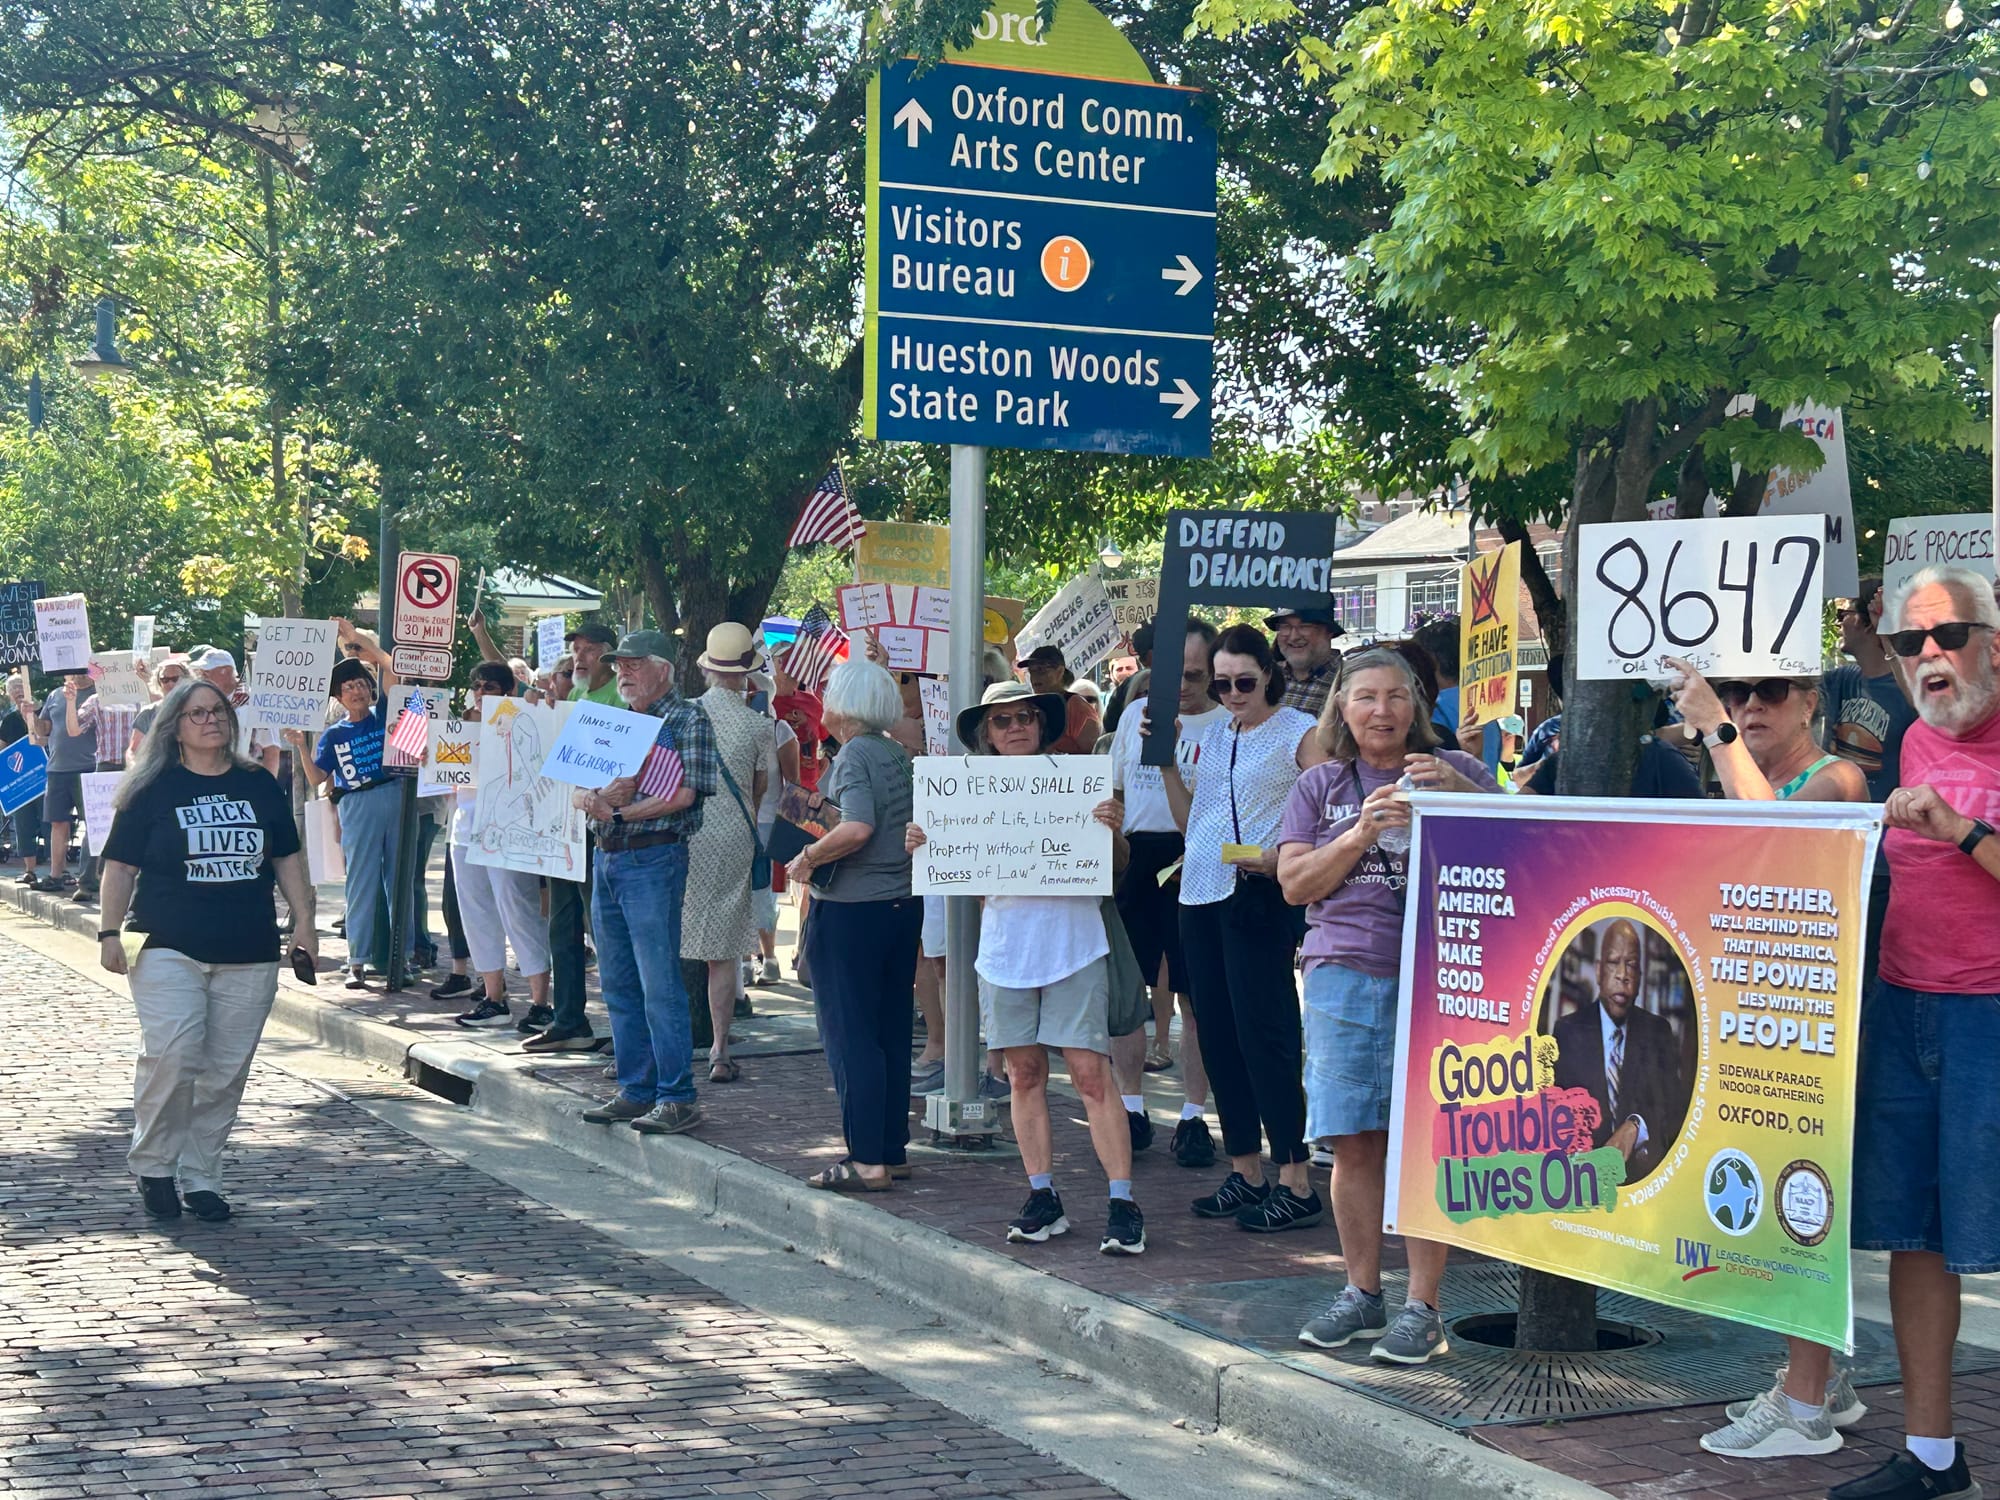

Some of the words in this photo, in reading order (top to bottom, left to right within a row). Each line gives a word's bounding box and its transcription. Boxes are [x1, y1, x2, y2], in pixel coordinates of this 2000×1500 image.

[972, 8, 1048, 46] ord
[951, 84, 1065, 130] Oxford
[1081, 98, 1194, 144] Comm.
[951, 133, 1019, 173] Arts
[1034, 141, 1146, 185] Center
[890, 204, 1022, 251] Visitors
[891, 254, 1015, 298] Bureau
[890, 335, 1032, 378] Hueston
[1049, 346, 1160, 387] Woods
[888, 384, 978, 422] State
[996, 389, 1070, 428] Park
[1179, 517, 1286, 552] DEFEND
[1885, 529, 1918, 565] DUE
[1924, 529, 1994, 564] PROCES
[1188, 553, 1332, 593] DEMOCRACY
[1136, 579, 1157, 598] IS
[1595, 535, 1821, 659] 8647
[399, 614, 430, 624] LOADING
[432, 617, 451, 626] ZONE
[1044, 594, 1085, 641] CHECKS
[1057, 598, 1109, 651] ALANCES
[1115, 604, 1156, 625] EGAL
[265, 626, 295, 641] GET
[301, 627, 326, 644] IN
[404, 624, 419, 635] 30
[423, 625, 444, 638] MIN
[1481, 624, 1509, 656] HAVE
[0, 646, 40, 665] WOMA
[275, 650, 314, 666] GOOD
[399, 652, 445, 664] COMMERCIAL
[1067, 630, 1112, 672] YRANNY
[395, 662, 427, 672] VEHICLES
[429, 664, 448, 674] ONLY
[256, 672, 327, 693] TROUBLE
[253, 693, 325, 712] NECESSARY
[258, 710, 311, 727] TROUBLE
[445, 721, 463, 734] NO
[578, 713, 612, 731] HANDS
[556, 744, 627, 777] NEIGHBORS
[435, 771, 471, 785] KINGS
[967, 775, 1026, 796] PERSON
[1031, 776, 1075, 795] SHALL
[1083, 776, 1105, 795] BE
[1135, 771, 1161, 782] WWI
[182, 802, 252, 825] BLACK
[927, 810, 978, 832] Deprived
[983, 811, 997, 825] of
[1034, 810, 1089, 829] Liberty
[1325, 804, 1354, 821] LWV
[198, 830, 258, 853] LIVES
[929, 840, 980, 861] Property
[1041, 837, 1072, 854] Due
[190, 859, 255, 878] MATTER
[927, 865, 973, 883] Process
[977, 865, 993, 879] of
[1047, 859, 1069, 871] The
[1438, 865, 1506, 890] ACROSS
[1438, 891, 1516, 917] AMERICA
[1590, 886, 1642, 904] Necessary
[1719, 883, 1840, 918] TOGETHER,
[1438, 916, 1481, 940] LET'S
[1709, 913, 1744, 931] WE'LL
[1745, 917, 1798, 934] REMIND
[1800, 921, 1839, 939] THEM
[1438, 942, 1483, 967] MAKE
[1535, 927, 1558, 967] Good
[1678, 930, 1697, 957] and
[1724, 937, 1753, 953] THAT
[1754, 941, 1770, 956] IN
[1772, 943, 1838, 964] AMERICA,
[1437, 967, 1484, 993] GOOD
[1691, 956, 1705, 993] help
[1710, 957, 1749, 982] THE
[1752, 961, 1838, 992] POWER
[1437, 993, 1511, 1024] TROUBLE
[1737, 991, 1766, 1008] LIES
[1768, 994, 1804, 1013] WITH
[1807, 998, 1835, 1017] THE
[1719, 1010, 1836, 1055] PEOPLE
[1439, 1035, 1534, 1102] Good
[1698, 1065, 1710, 1093] the
[1718, 1063, 1776, 1082] SIDEWALK
[1719, 1079, 1761, 1096] INDOOR
[1762, 1086, 1825, 1105] GATHERING
[1440, 1092, 1576, 1156] Trouble
[1718, 1103, 1793, 1134] OXFORD,
[1797, 1116, 1824, 1136] OH
[1673, 1144, 1690, 1168] OF
[1444, 1156, 1534, 1213] Lives
[1539, 1149, 1600, 1210] On
[1675, 1237, 1712, 1268] LWV
[1716, 1249, 1751, 1266] LEAGUE
[1751, 1257, 1763, 1267] OF
[1763, 1259, 1799, 1275] WOMEN
[1799, 1266, 1831, 1284] VOTERS
[1725, 1262, 1738, 1274] OF
[1738, 1265, 1774, 1281] OXFORD
